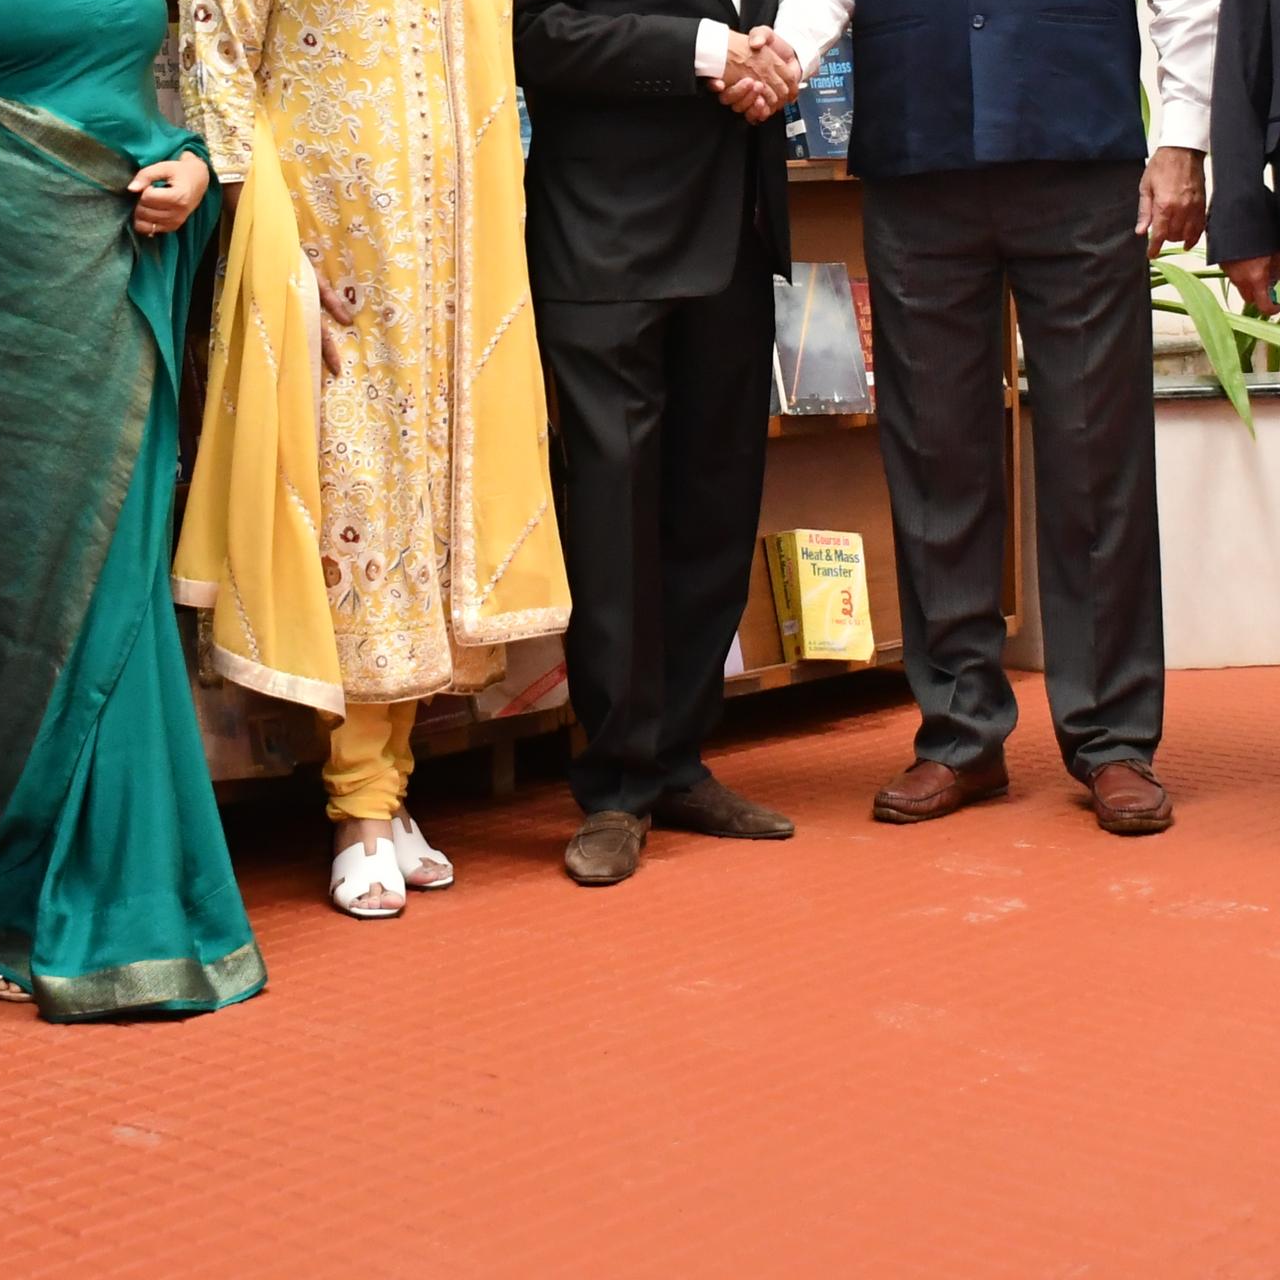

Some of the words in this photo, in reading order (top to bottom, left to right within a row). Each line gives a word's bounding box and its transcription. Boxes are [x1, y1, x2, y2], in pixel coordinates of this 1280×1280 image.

[828, 61, 852, 74] Mass
[810, 75, 845, 89] Transfer
[808, 534, 815, 544] A
[815, 534, 841, 546] Course
[843, 536, 850, 547] in
[801, 547, 824, 560] Heat
[825, 548, 833, 560] &
[834, 549, 861, 563] Mass
[811, 562, 853, 578] Transfer
